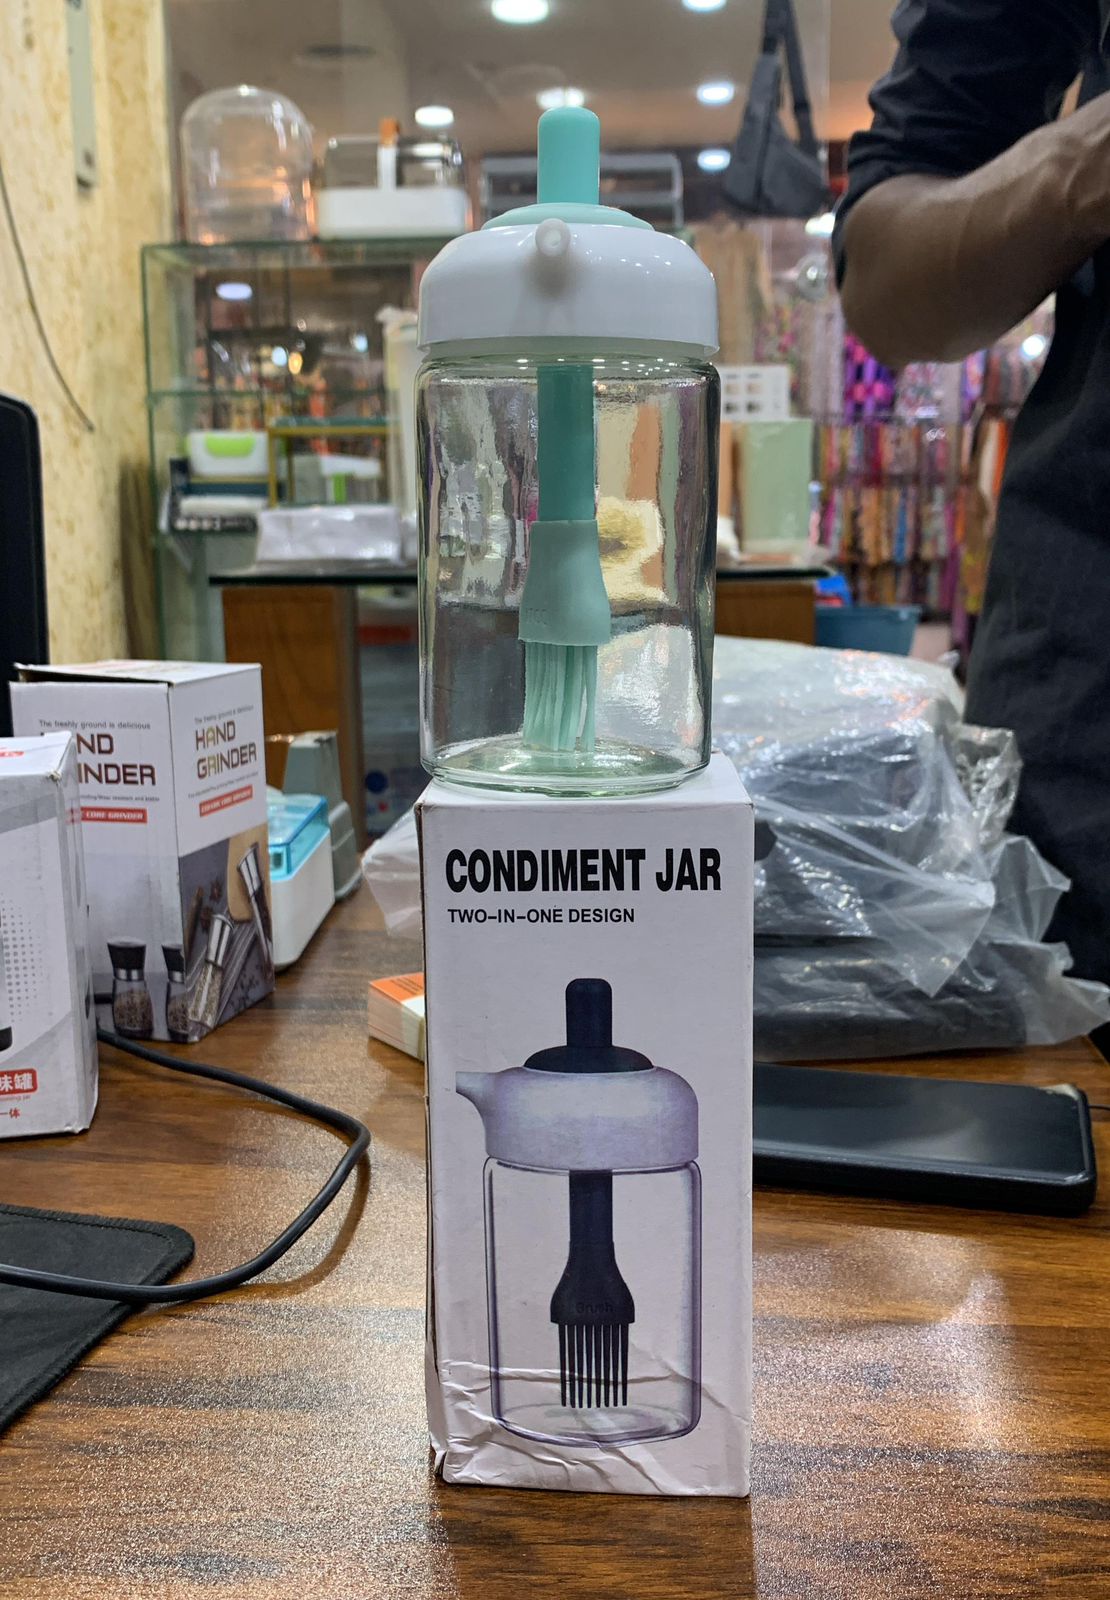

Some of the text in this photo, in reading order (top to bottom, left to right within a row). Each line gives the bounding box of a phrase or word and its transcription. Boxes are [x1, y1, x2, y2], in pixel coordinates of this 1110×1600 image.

[39, 719, 52, 727] The
[80, 720, 107, 730] ground
[195, 720, 236, 751] HAND
[75, 732, 115, 755] ND
[196, 742, 257, 779] GRINDER
[77, 762, 156, 785] INDER
[445, 848, 721, 893] CONDIMENT JAR
[568, 908, 635, 923] DESIGN
[576, 1302, 613, 1314] Brush
